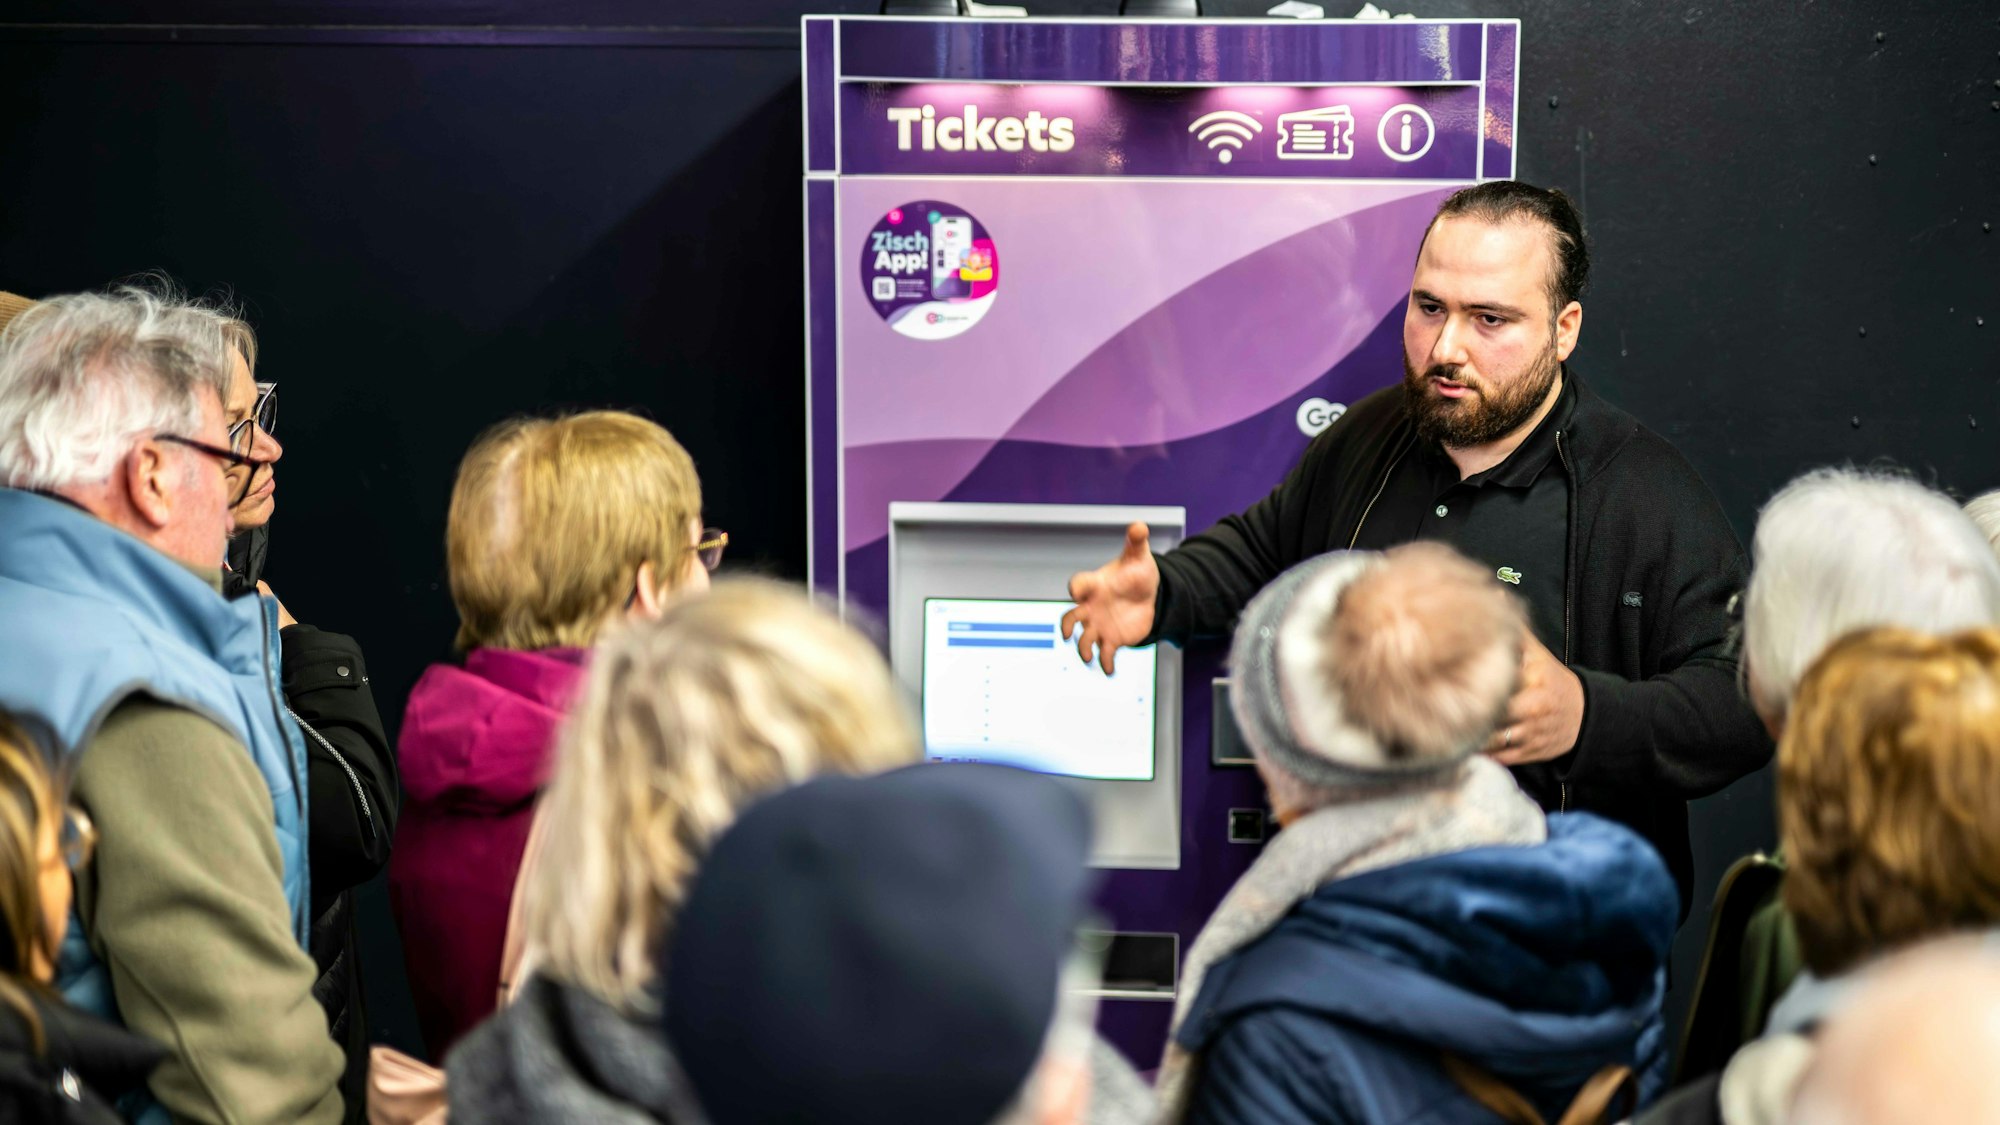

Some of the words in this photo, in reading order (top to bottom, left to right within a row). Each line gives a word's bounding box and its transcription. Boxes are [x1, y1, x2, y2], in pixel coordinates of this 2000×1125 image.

[887, 104, 1075, 151] Tickets
[872, 231, 929, 251] Zisch
[874, 250, 928, 274] App!
